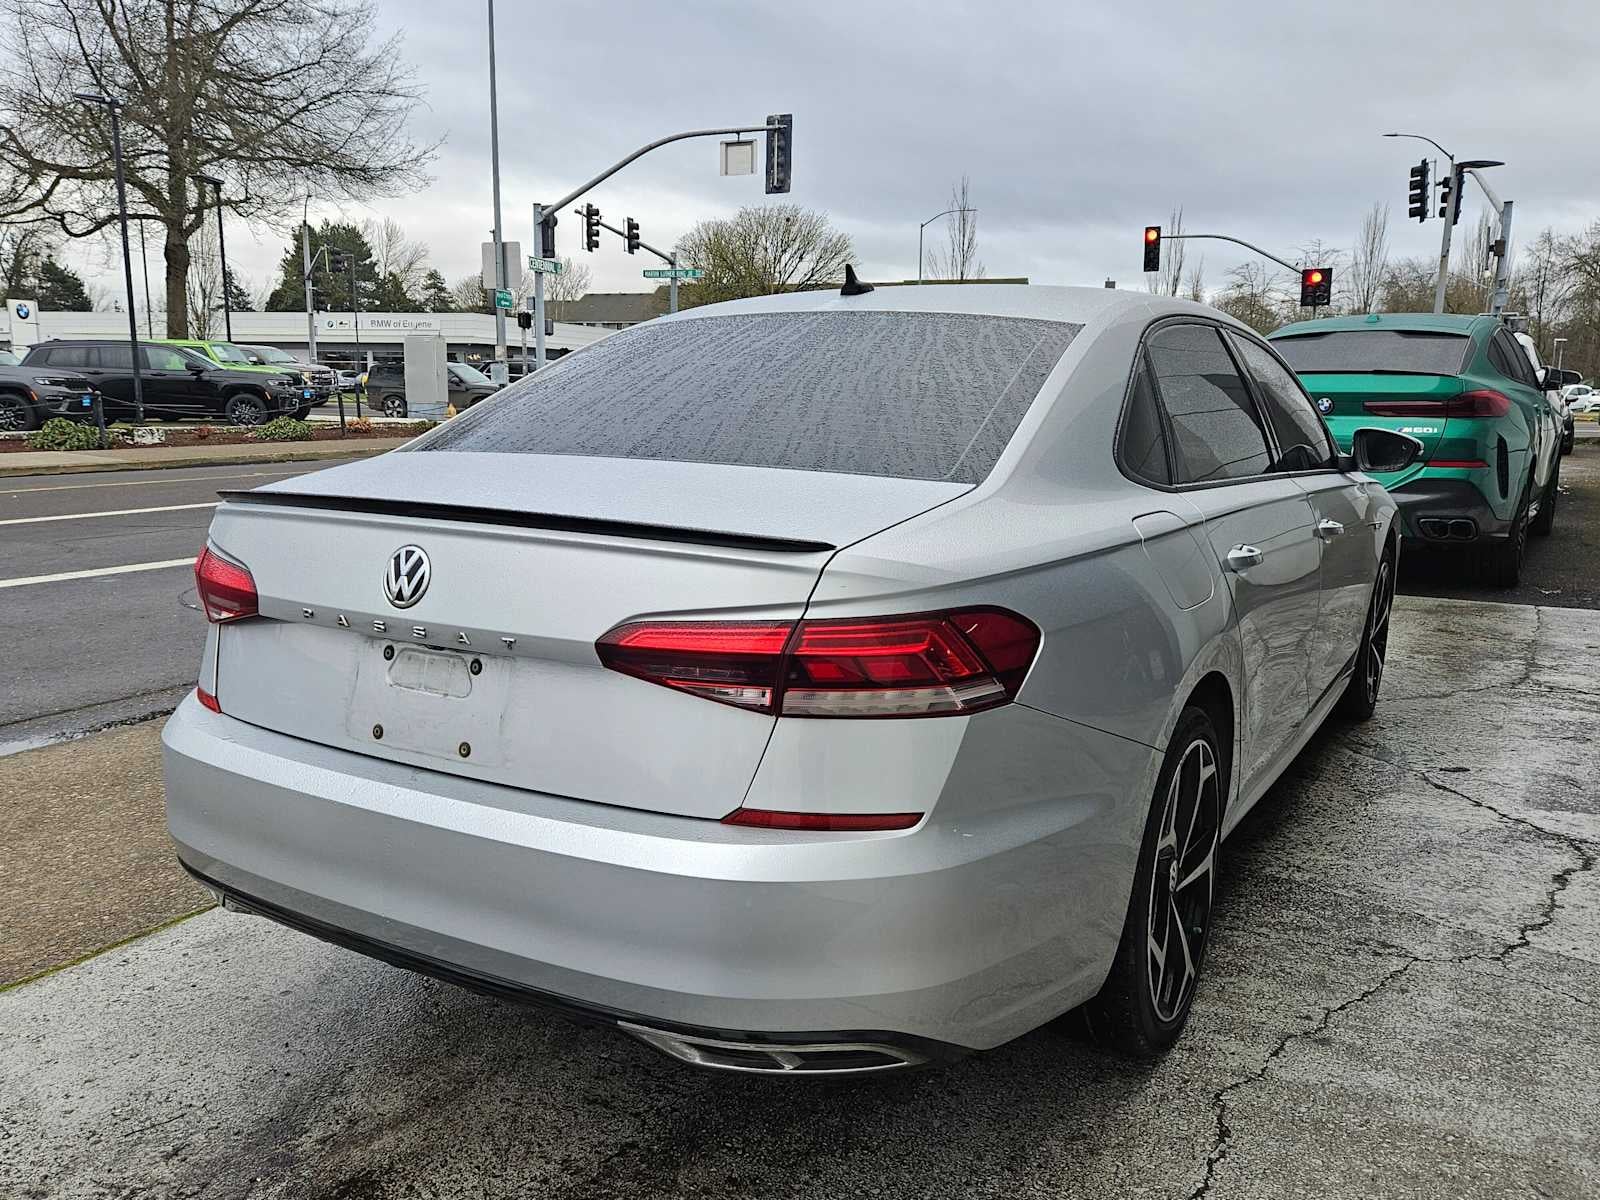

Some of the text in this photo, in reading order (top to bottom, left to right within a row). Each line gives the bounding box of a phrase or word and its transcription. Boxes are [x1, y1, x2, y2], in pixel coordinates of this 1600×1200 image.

[370, 319, 392, 328] BMW
[393, 319, 401, 328] of
[302, 607, 517, 650] PASSAT
